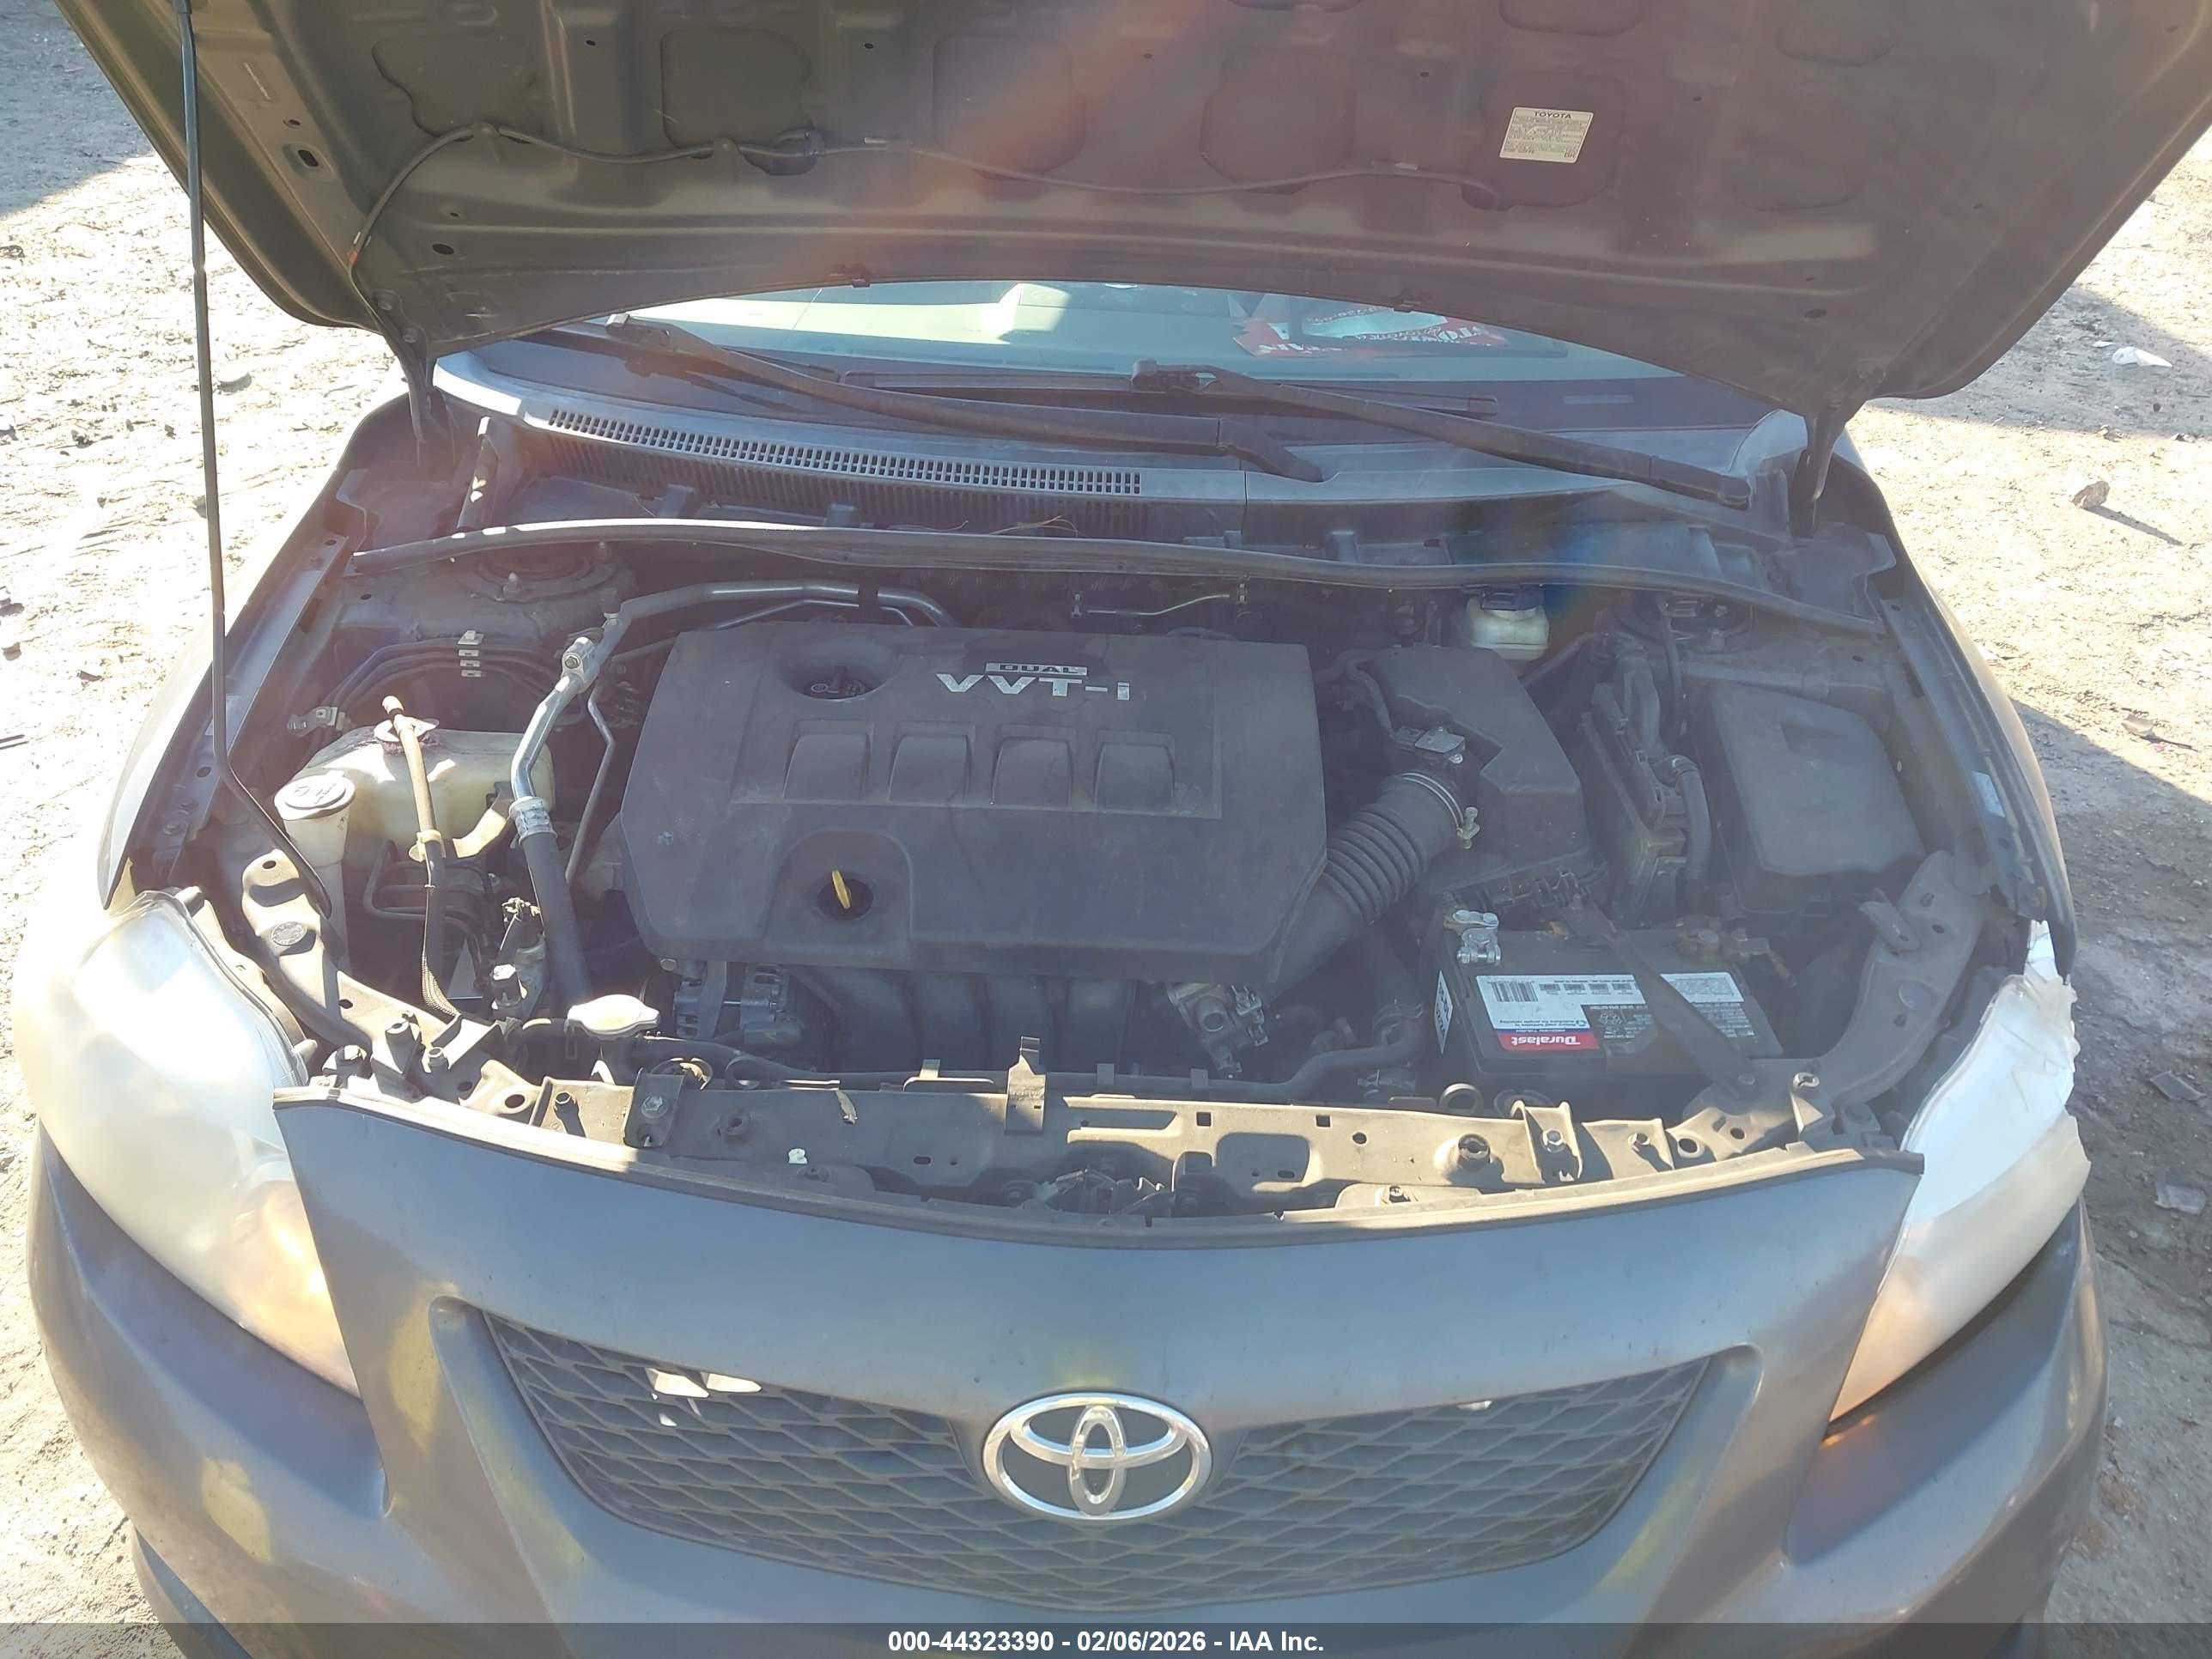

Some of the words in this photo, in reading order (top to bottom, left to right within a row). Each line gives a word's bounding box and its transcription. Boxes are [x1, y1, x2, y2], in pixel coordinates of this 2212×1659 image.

[1533, 111, 1572, 119] TOYOTA
[998, 664, 1082, 674] DUAL
[935, 673, 1130, 701] VVT-i
[1511, 1036, 1581, 1046] Duralast
